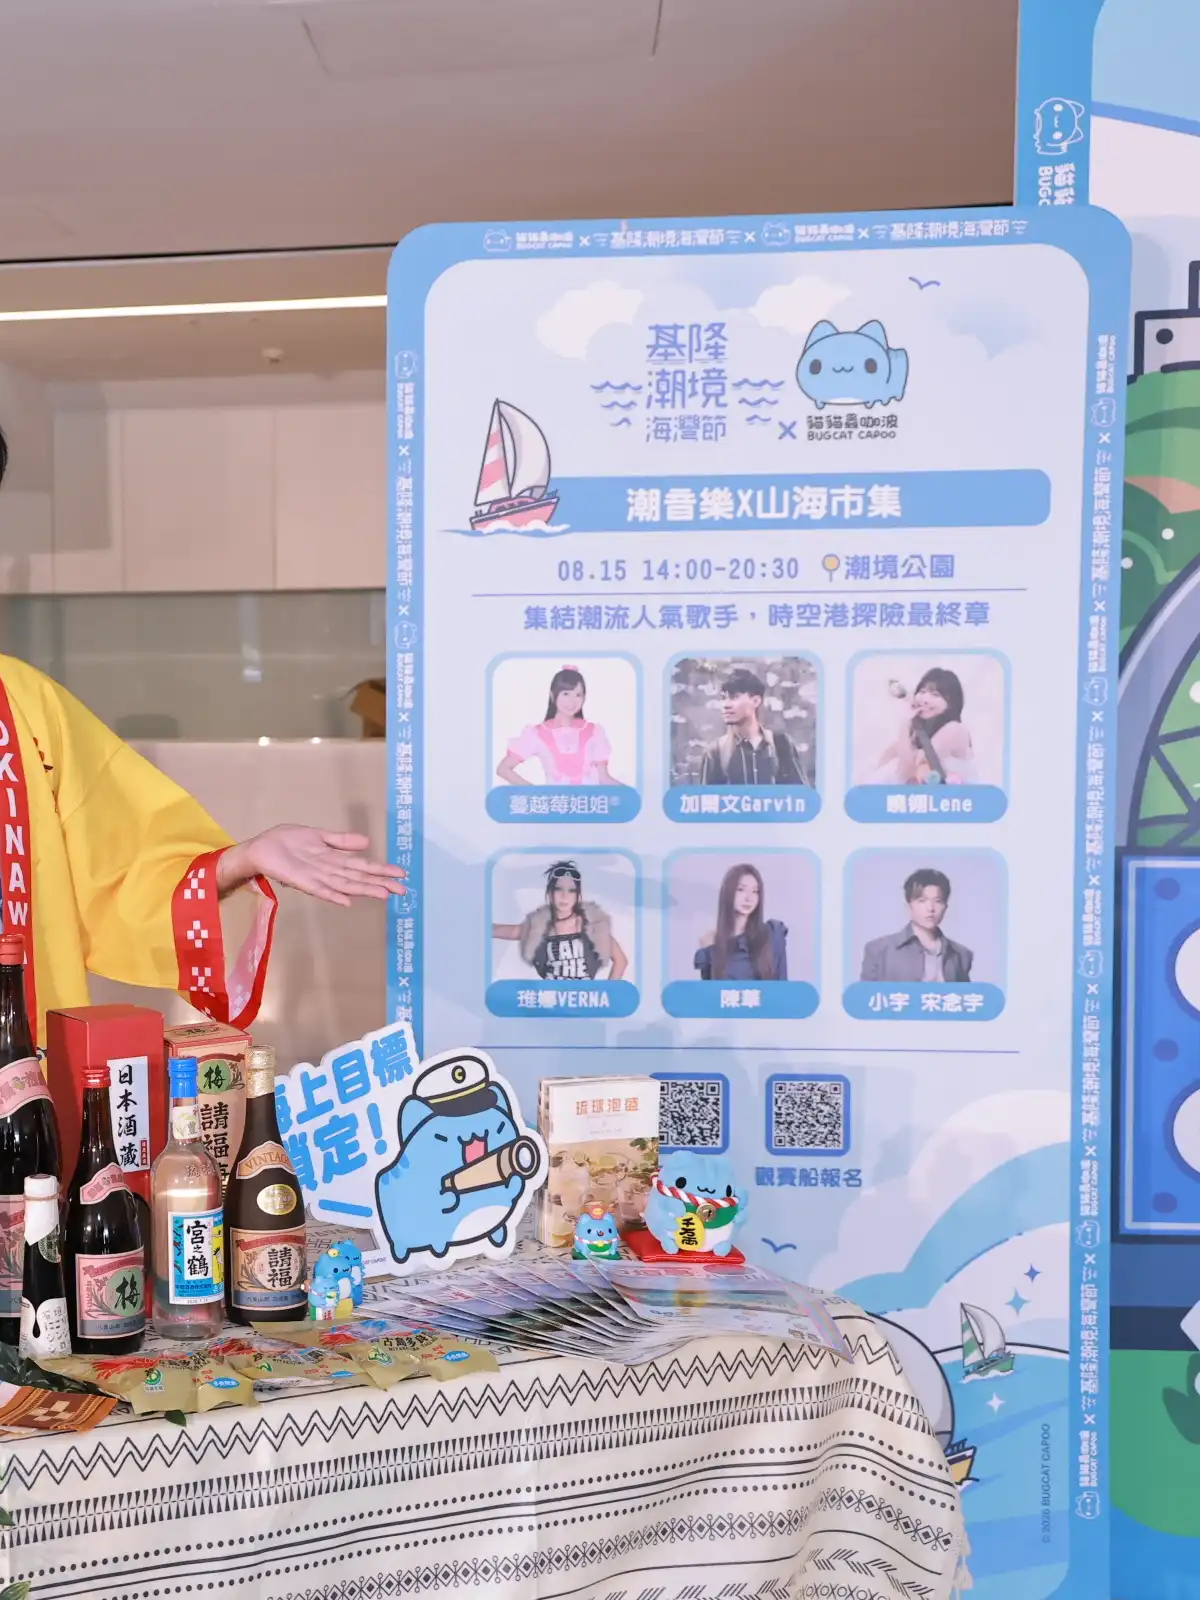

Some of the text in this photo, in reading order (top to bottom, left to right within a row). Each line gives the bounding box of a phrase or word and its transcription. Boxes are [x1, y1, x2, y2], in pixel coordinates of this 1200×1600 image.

[646, 322, 728, 362] 基隆
[646, 368, 728, 409] 潮境
[646, 415, 726, 442] 海灣節
[807, 430, 896, 440] BUGCAT CAPOO
[626, 485, 901, 522] 潮音樂X山海市集
[558, 557, 799, 581] 08.15 14:00-20:30
[844, 553, 954, 580] 潮境公園
[203, 1066, 226, 1090] 梅
[187, 1220, 209, 1276] 宮之鶴
[268, 1247, 292, 1288] 請福
[114, 1273, 140, 1310] 梅
[1042, 1423, 1050, 1462] CAPOO
[1042, 1463, 1050, 1507] BUGCAT
